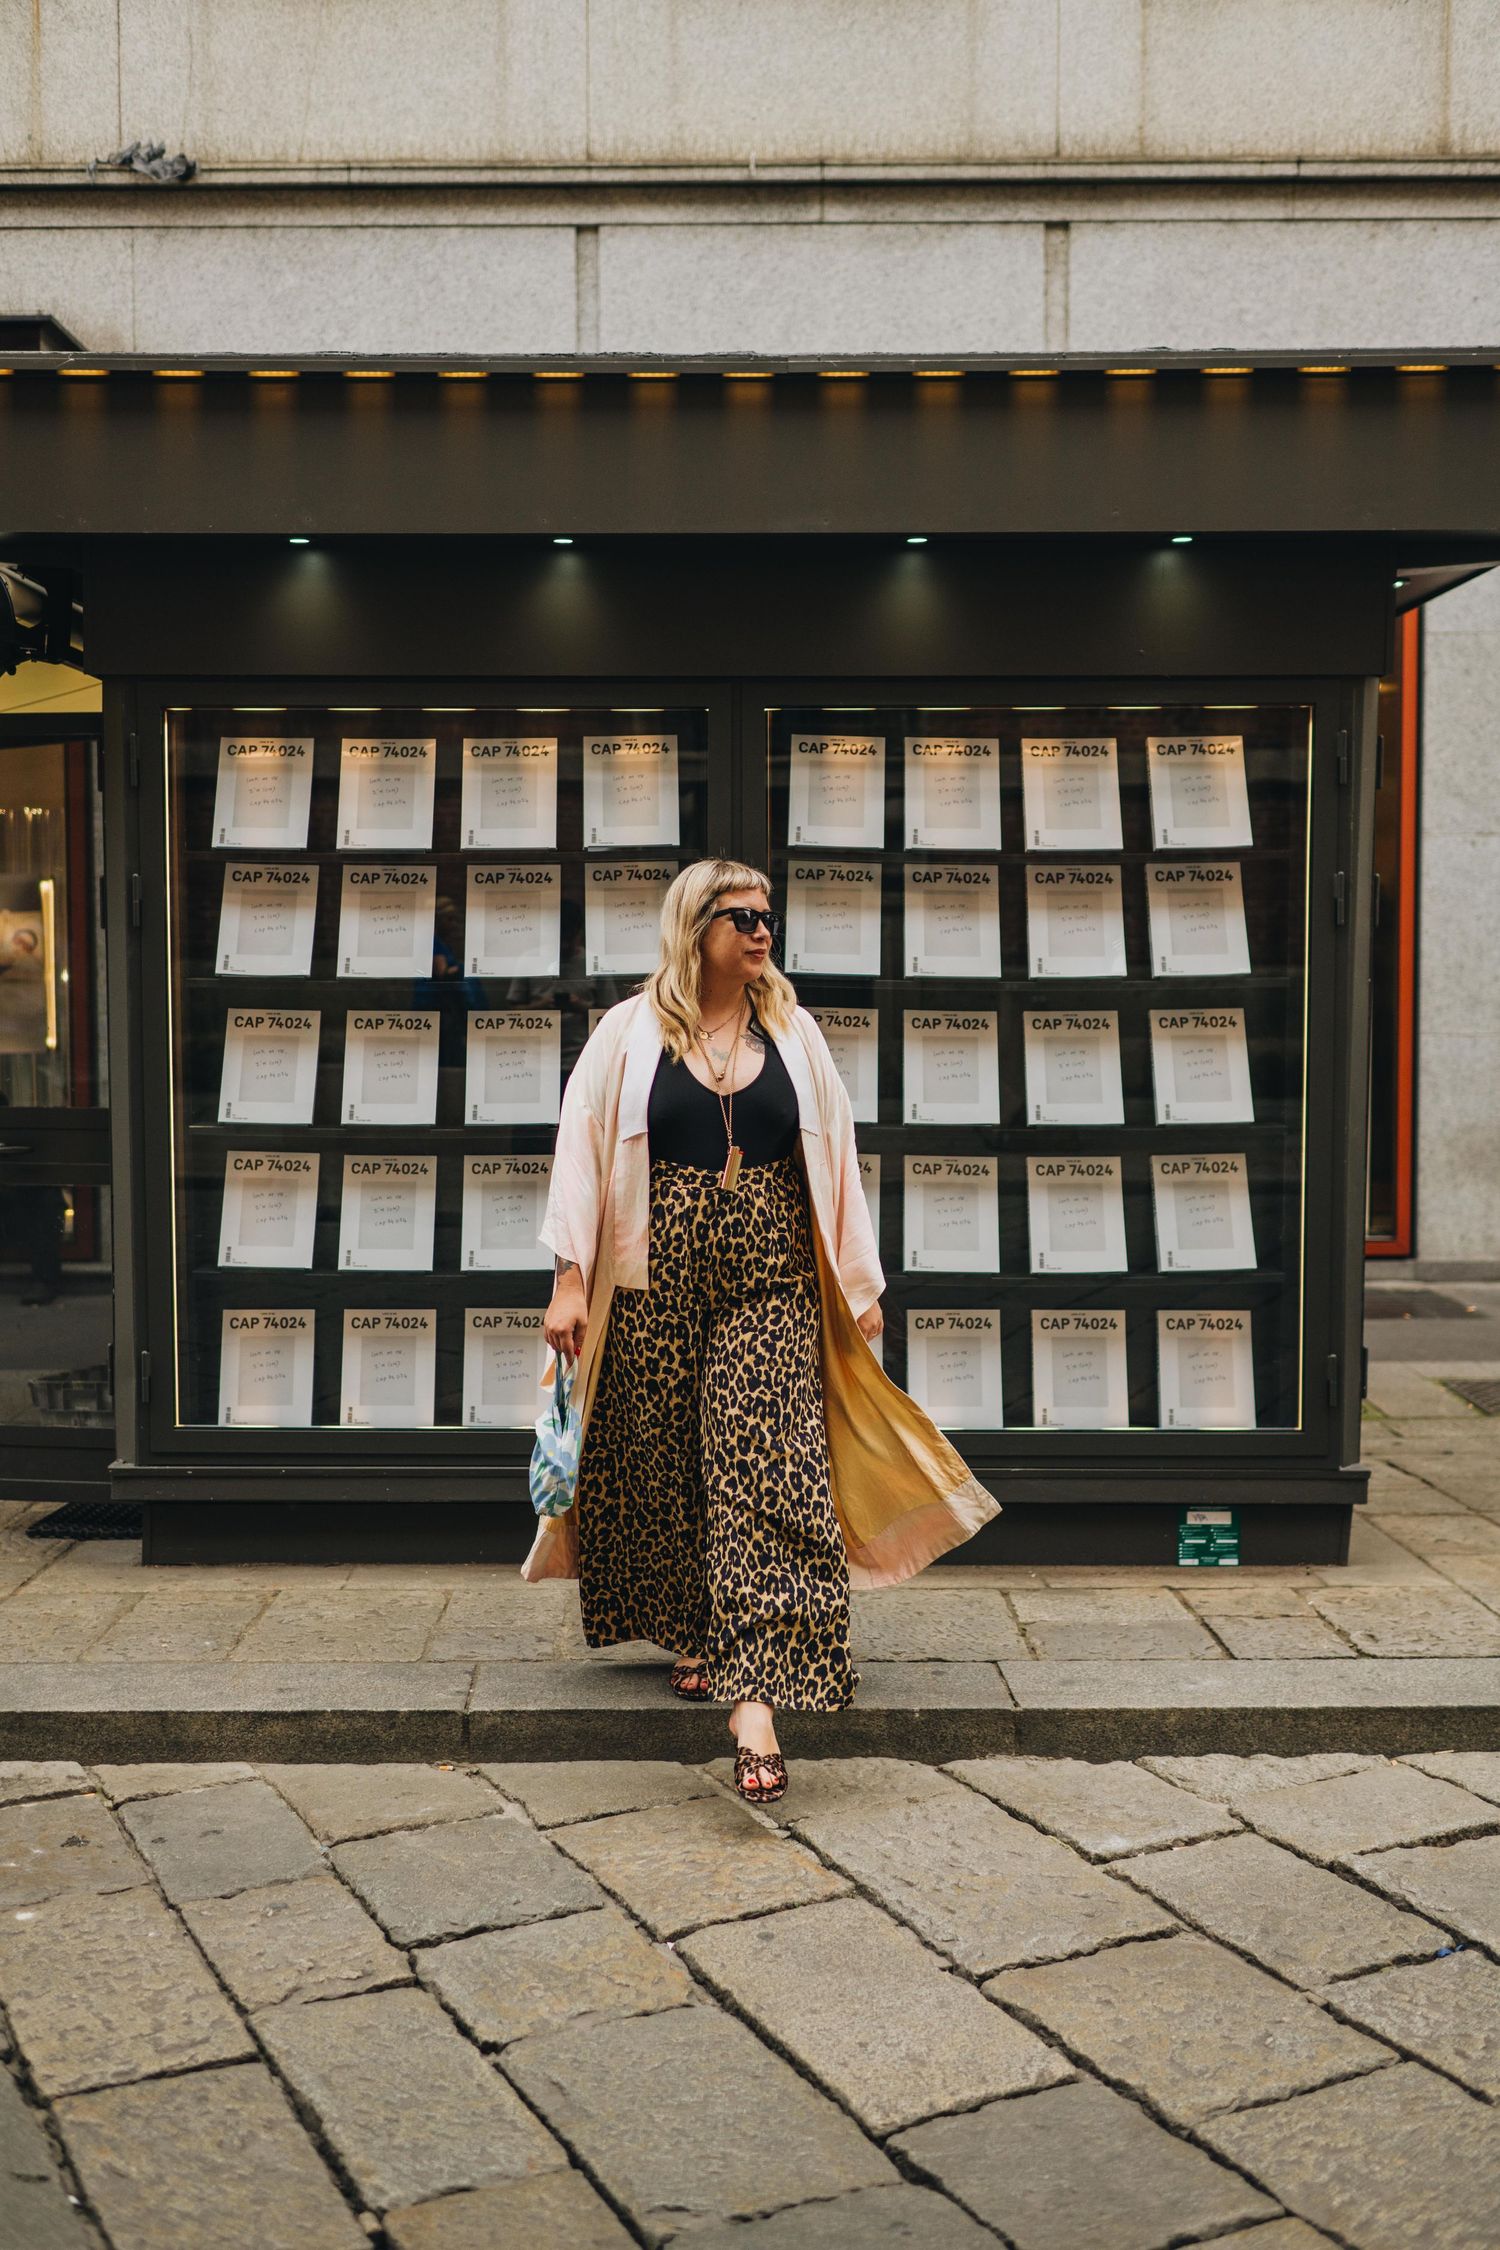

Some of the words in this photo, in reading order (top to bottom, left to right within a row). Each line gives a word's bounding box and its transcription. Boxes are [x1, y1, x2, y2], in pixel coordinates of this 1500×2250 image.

[226, 744, 258, 757] CAP
[261, 744, 306, 758] 74024
[349, 745, 380, 758] CAP
[383, 745, 428, 758] 74024
[470, 745, 502, 758] CAP
[504, 744, 550, 758] 74024
[591, 743, 622, 755] CAP
[624, 742, 670, 755] 74024
[798, 741, 830, 754] CAP
[832, 742, 878, 756] 74024
[912, 743, 943, 756] CAP
[946, 743, 992, 757] 74024
[1030, 745, 1061, 758] CAP
[1063, 745, 1110, 758] 74024
[1156, 743, 1187, 756] CAP
[1189, 743, 1236, 756] 74024
[231, 870, 263, 883] CAP
[266, 871, 311, 884] 74024
[349, 871, 381, 885] CAP
[383, 872, 429, 885] 74024
[474, 872, 506, 885] CAP
[508, 871, 553, 885] 74024
[592, 869, 623, 882] CAP
[626, 868, 672, 881] 74024
[794, 867, 826, 881] CAP
[828, 869, 875, 883] 74024
[911, 870, 943, 884] CAP
[945, 871, 992, 885] 74024
[1034, 871, 1066, 885] CAP
[1068, 871, 1114, 885] 74024
[1154, 870, 1186, 883] CAP
[1188, 869, 1234, 882] 74024
[234, 1015, 265, 1029] CAP
[267, 1016, 313, 1030] 74024
[353, 1017, 385, 1031] CAP
[387, 1017, 433, 1031] 74024
[474, 1017, 506, 1030] CAP
[508, 1017, 553, 1030] 74024
[825, 1014, 871, 1028] 74024
[911, 1017, 942, 1030] CAP
[944, 1018, 990, 1031] 74024
[1031, 1018, 1063, 1031] CAP
[1065, 1017, 1111, 1031] 74024
[1158, 1016, 1189, 1029] CAP
[1191, 1015, 1238, 1029] 74024
[233, 1158, 264, 1171] CAP
[267, 1159, 312, 1173] 74024
[350, 1162, 382, 1175] CAP
[384, 1162, 429, 1176] 74024
[471, 1162, 502, 1175] CAP
[504, 1161, 549, 1175] 74024
[912, 1162, 943, 1176] CAP
[945, 1163, 991, 1177] 74024
[1035, 1164, 1066, 1177] CAP
[1068, 1163, 1114, 1177] 74024
[1160, 1162, 1191, 1175] CAP
[1193, 1160, 1240, 1174] 74024
[229, 1316, 260, 1330] CAP
[262, 1316, 307, 1330] 74024
[350, 1316, 382, 1330] CAP
[384, 1316, 429, 1330] 74024
[472, 1315, 503, 1329] CAP
[914, 1316, 945, 1330] CAP
[948, 1316, 993, 1330] 74024
[1040, 1317, 1071, 1330] CAP
[1073, 1317, 1119, 1330] 74024
[1165, 1317, 1196, 1331] CAP
[1199, 1317, 1244, 1331] 74024
